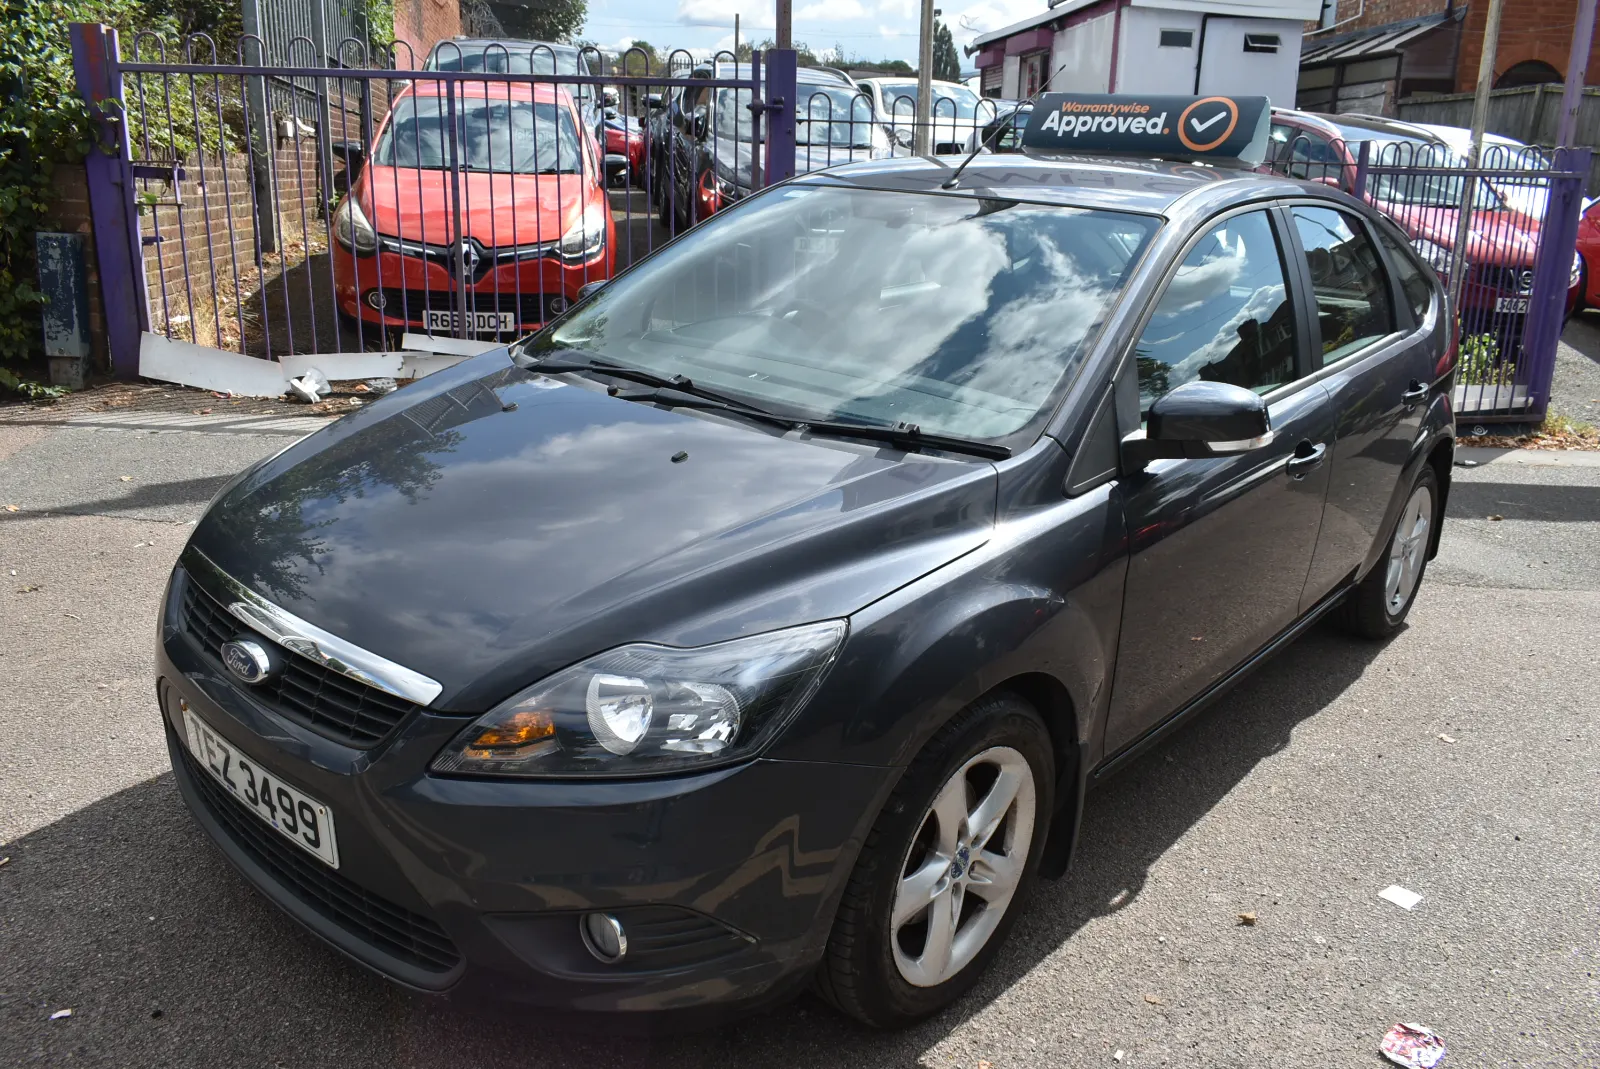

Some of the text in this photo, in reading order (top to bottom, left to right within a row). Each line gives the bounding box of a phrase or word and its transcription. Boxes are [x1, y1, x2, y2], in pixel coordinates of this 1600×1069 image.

[1062, 102, 1149, 114] Warrantywise
[1041, 110, 1170, 137] Approved.
[477, 315, 508, 329] DCH
[227, 647, 251, 675] Ford
[239, 760, 320, 849] 3499
